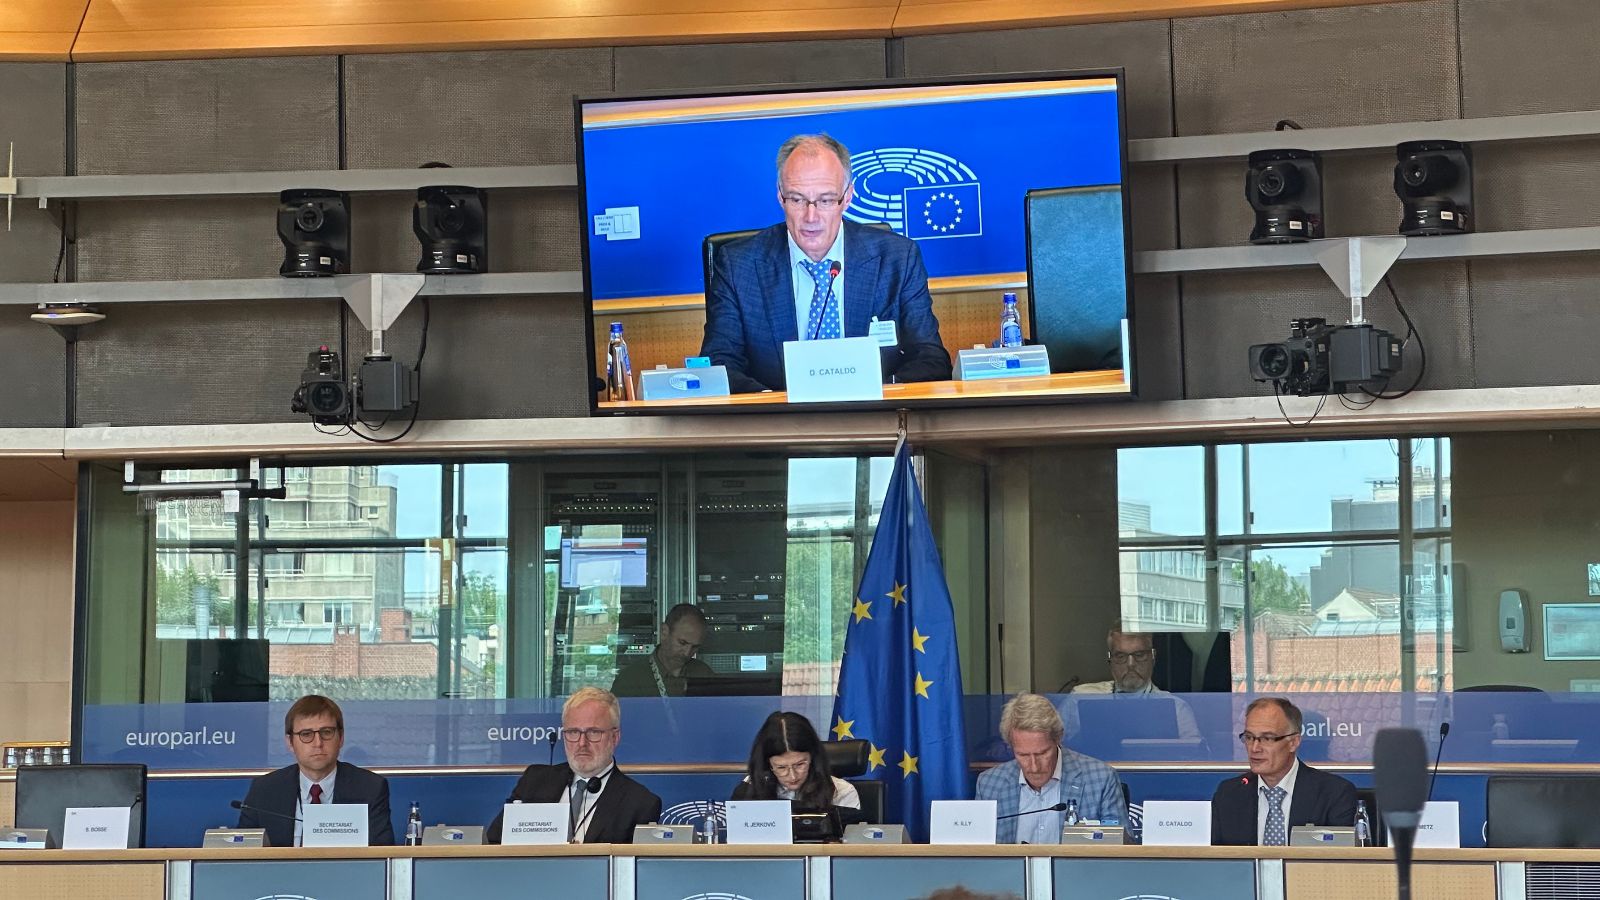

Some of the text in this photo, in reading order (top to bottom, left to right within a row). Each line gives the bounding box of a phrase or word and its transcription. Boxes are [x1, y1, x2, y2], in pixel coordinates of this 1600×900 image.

[819, 367, 856, 376] CATALDO
[126, 726, 236, 749] europarl.eu
[487, 726, 564, 745] europar
